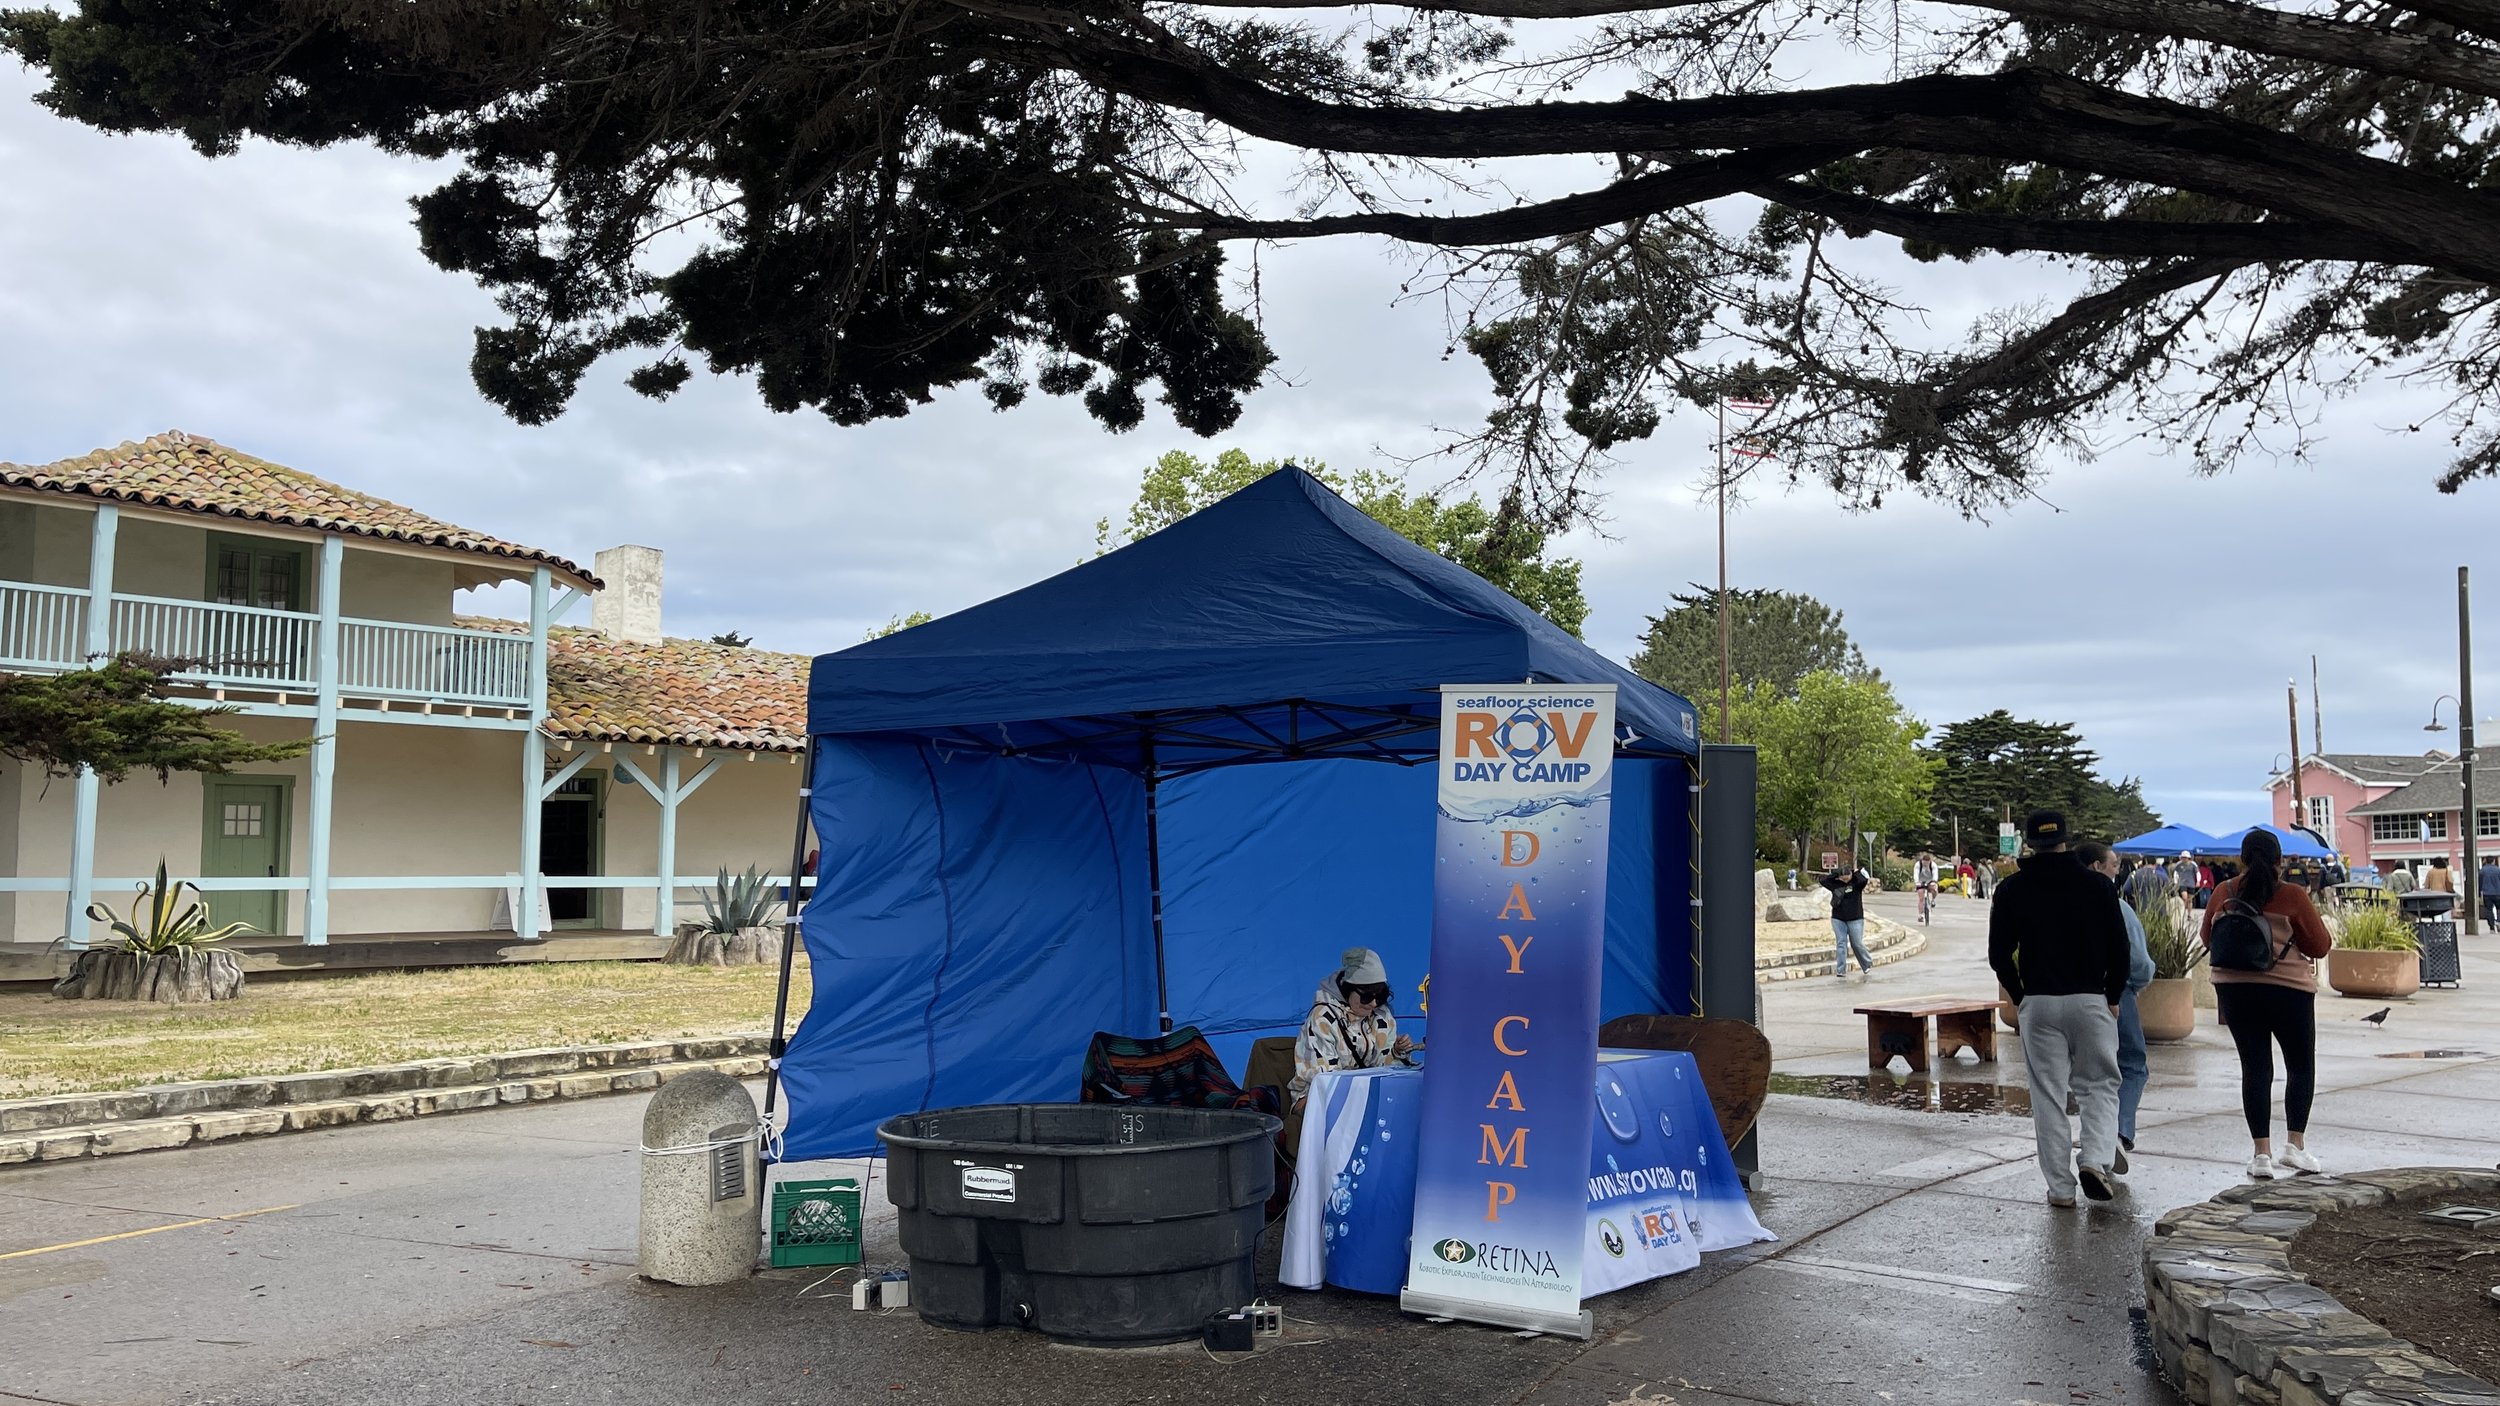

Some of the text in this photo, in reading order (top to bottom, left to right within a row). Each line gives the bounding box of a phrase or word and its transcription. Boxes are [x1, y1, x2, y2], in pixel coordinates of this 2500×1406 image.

[1456, 696, 1594, 708] seafloor science
[1455, 712, 1598, 758] ROV
[1454, 763, 1591, 783] DAY CAMP
[967, 1174, 1010, 1185] Rubbermaid
[1651, 1236, 1668, 1249] DAY
[1477, 1242, 1560, 1279] RETINA
